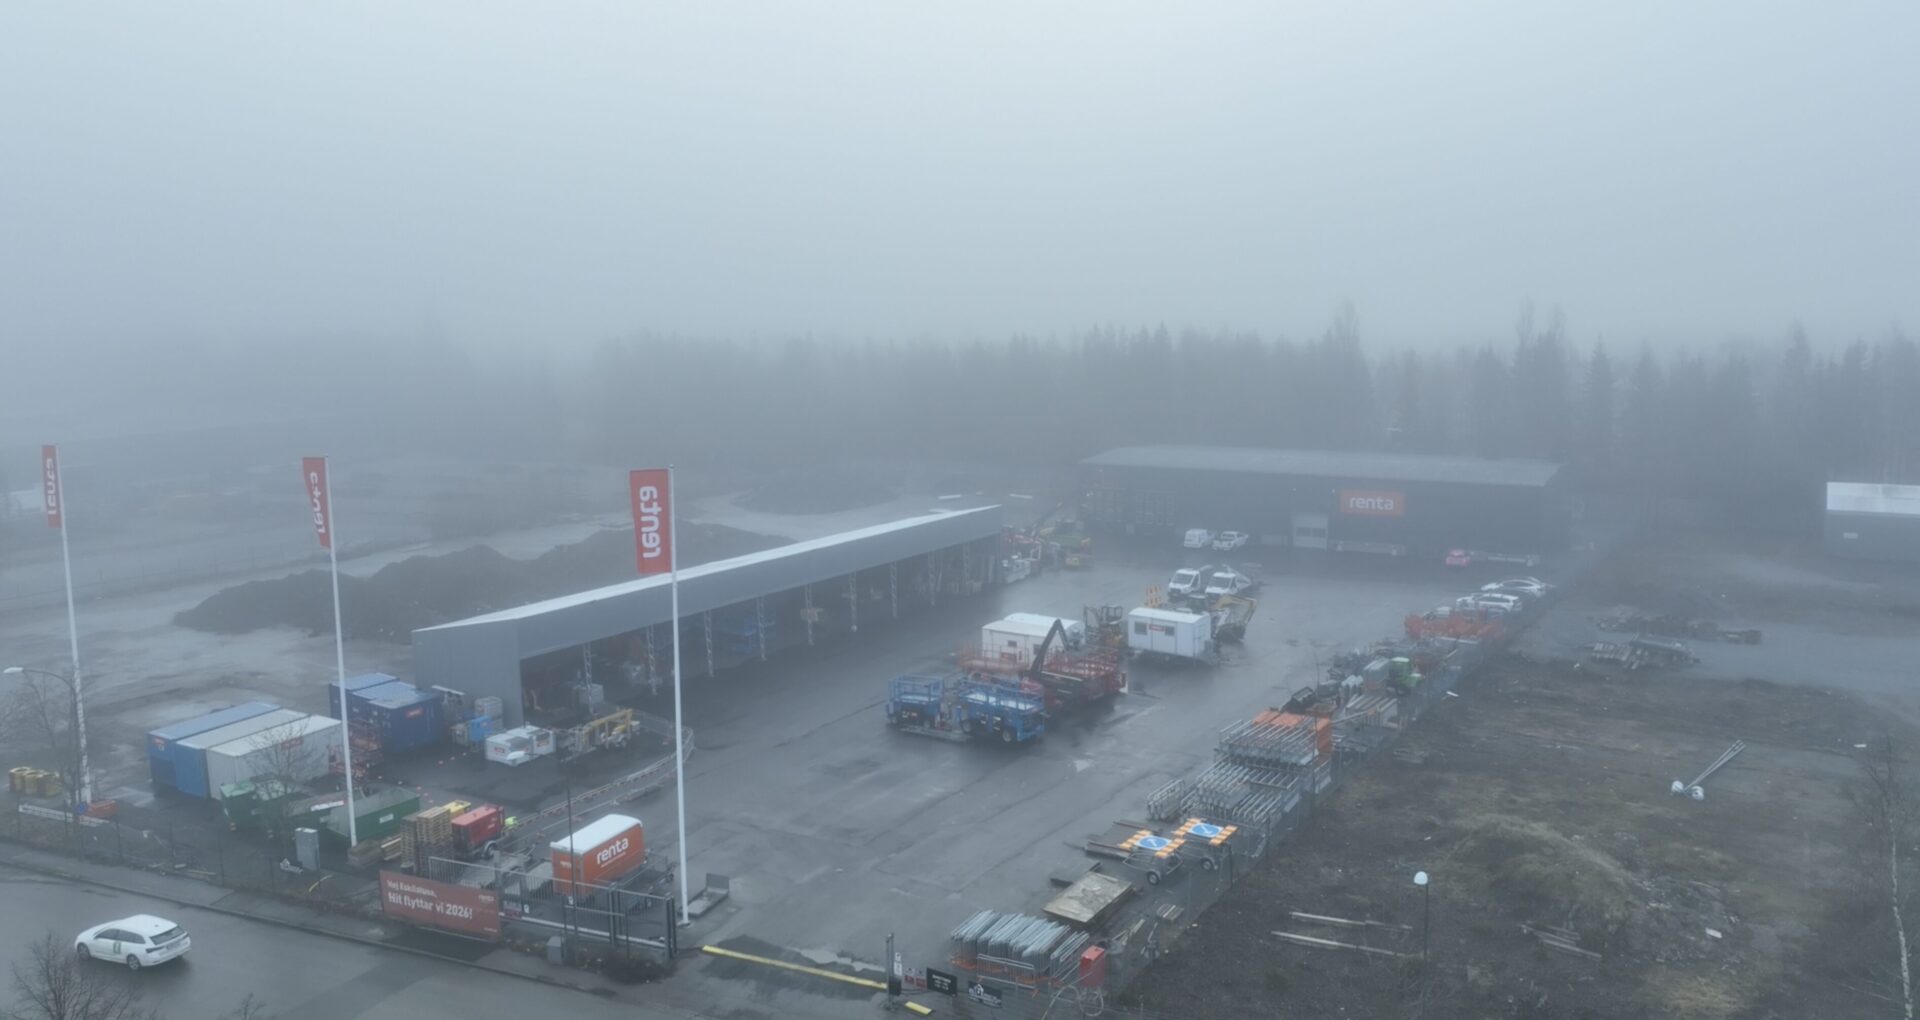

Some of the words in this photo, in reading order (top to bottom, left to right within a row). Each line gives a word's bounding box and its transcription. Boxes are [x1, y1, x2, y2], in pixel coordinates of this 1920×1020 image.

[1349, 495, 1394, 511] renta
[596, 837, 629, 865] renta
[388, 892, 402, 905] Hit
[404, 895, 433, 911] flyttar
[435, 902, 444, 914] vi
[445, 904, 473, 921] 2026!
